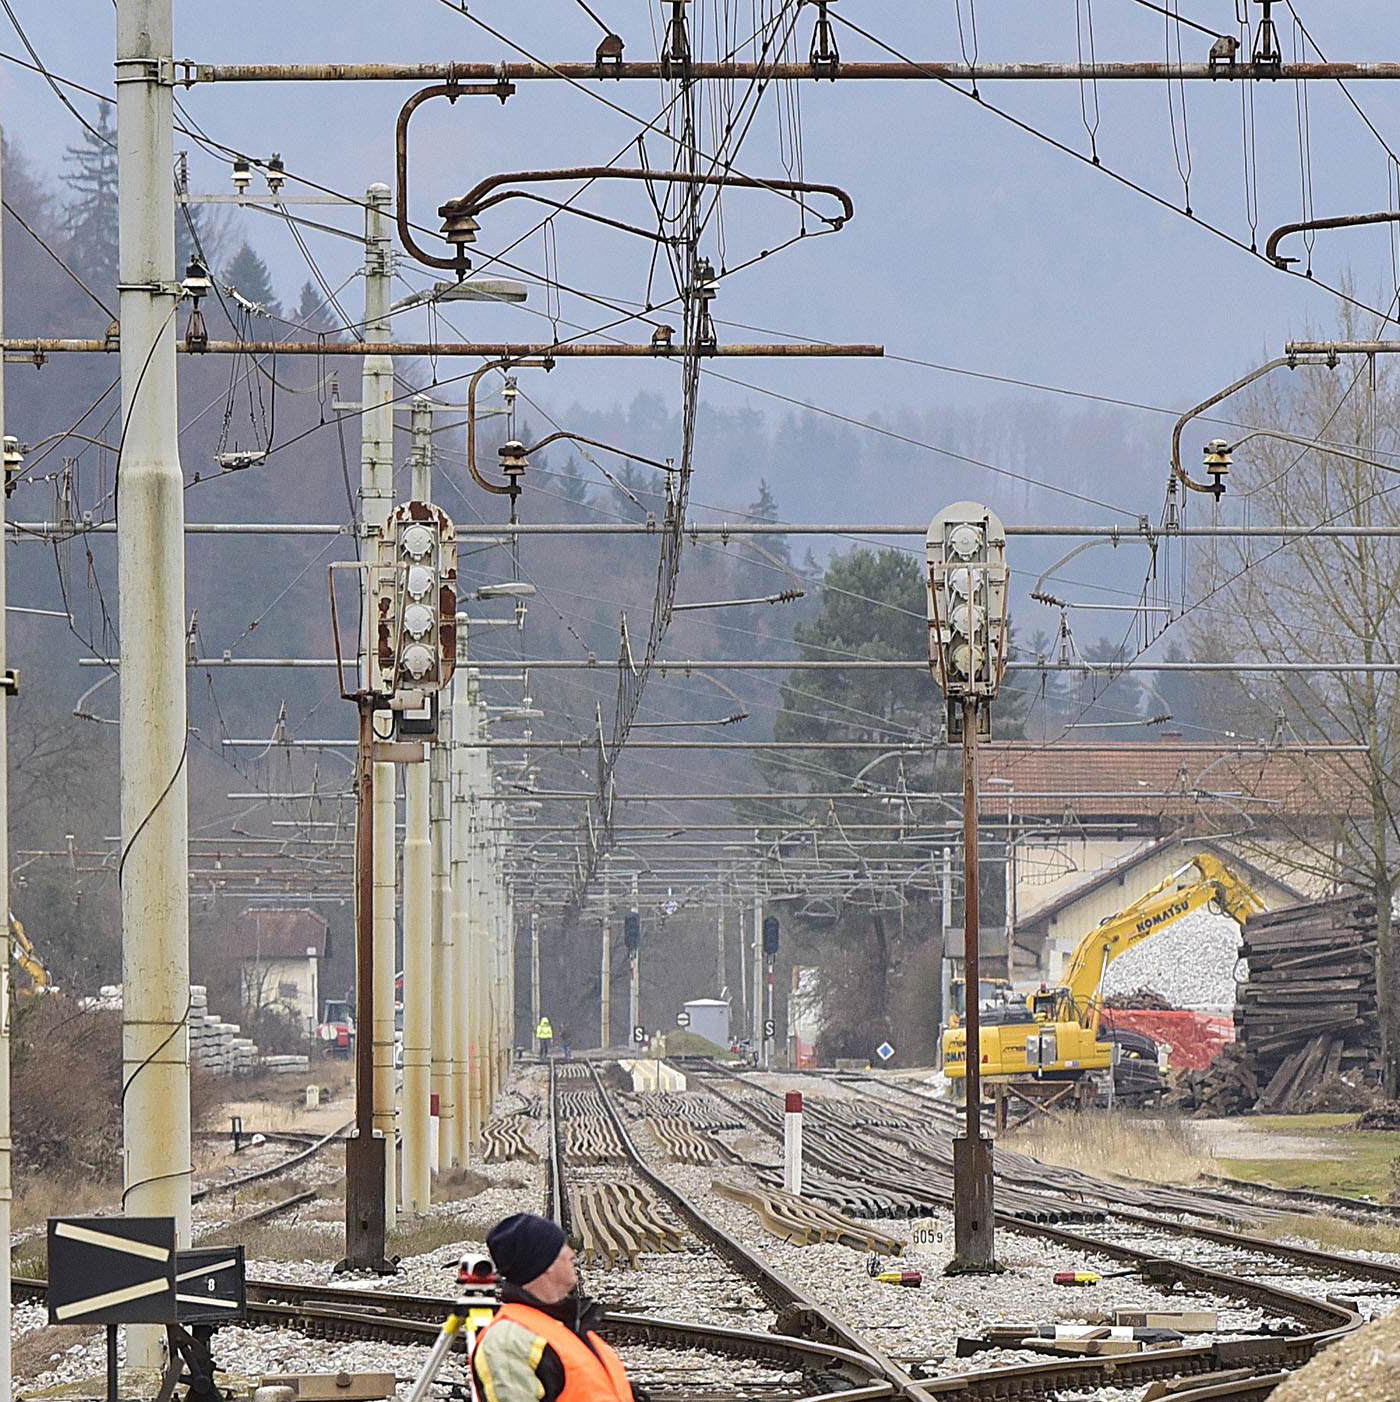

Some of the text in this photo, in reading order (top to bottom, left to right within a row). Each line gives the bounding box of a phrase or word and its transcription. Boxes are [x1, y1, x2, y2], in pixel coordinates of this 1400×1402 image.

[1136, 900, 1189, 932] KOMATSU
[635, 1027, 643, 1041] S
[766, 1021, 774, 1036] S
[913, 1229, 943, 1244] 6059
[207, 1278, 215, 1291] 8
